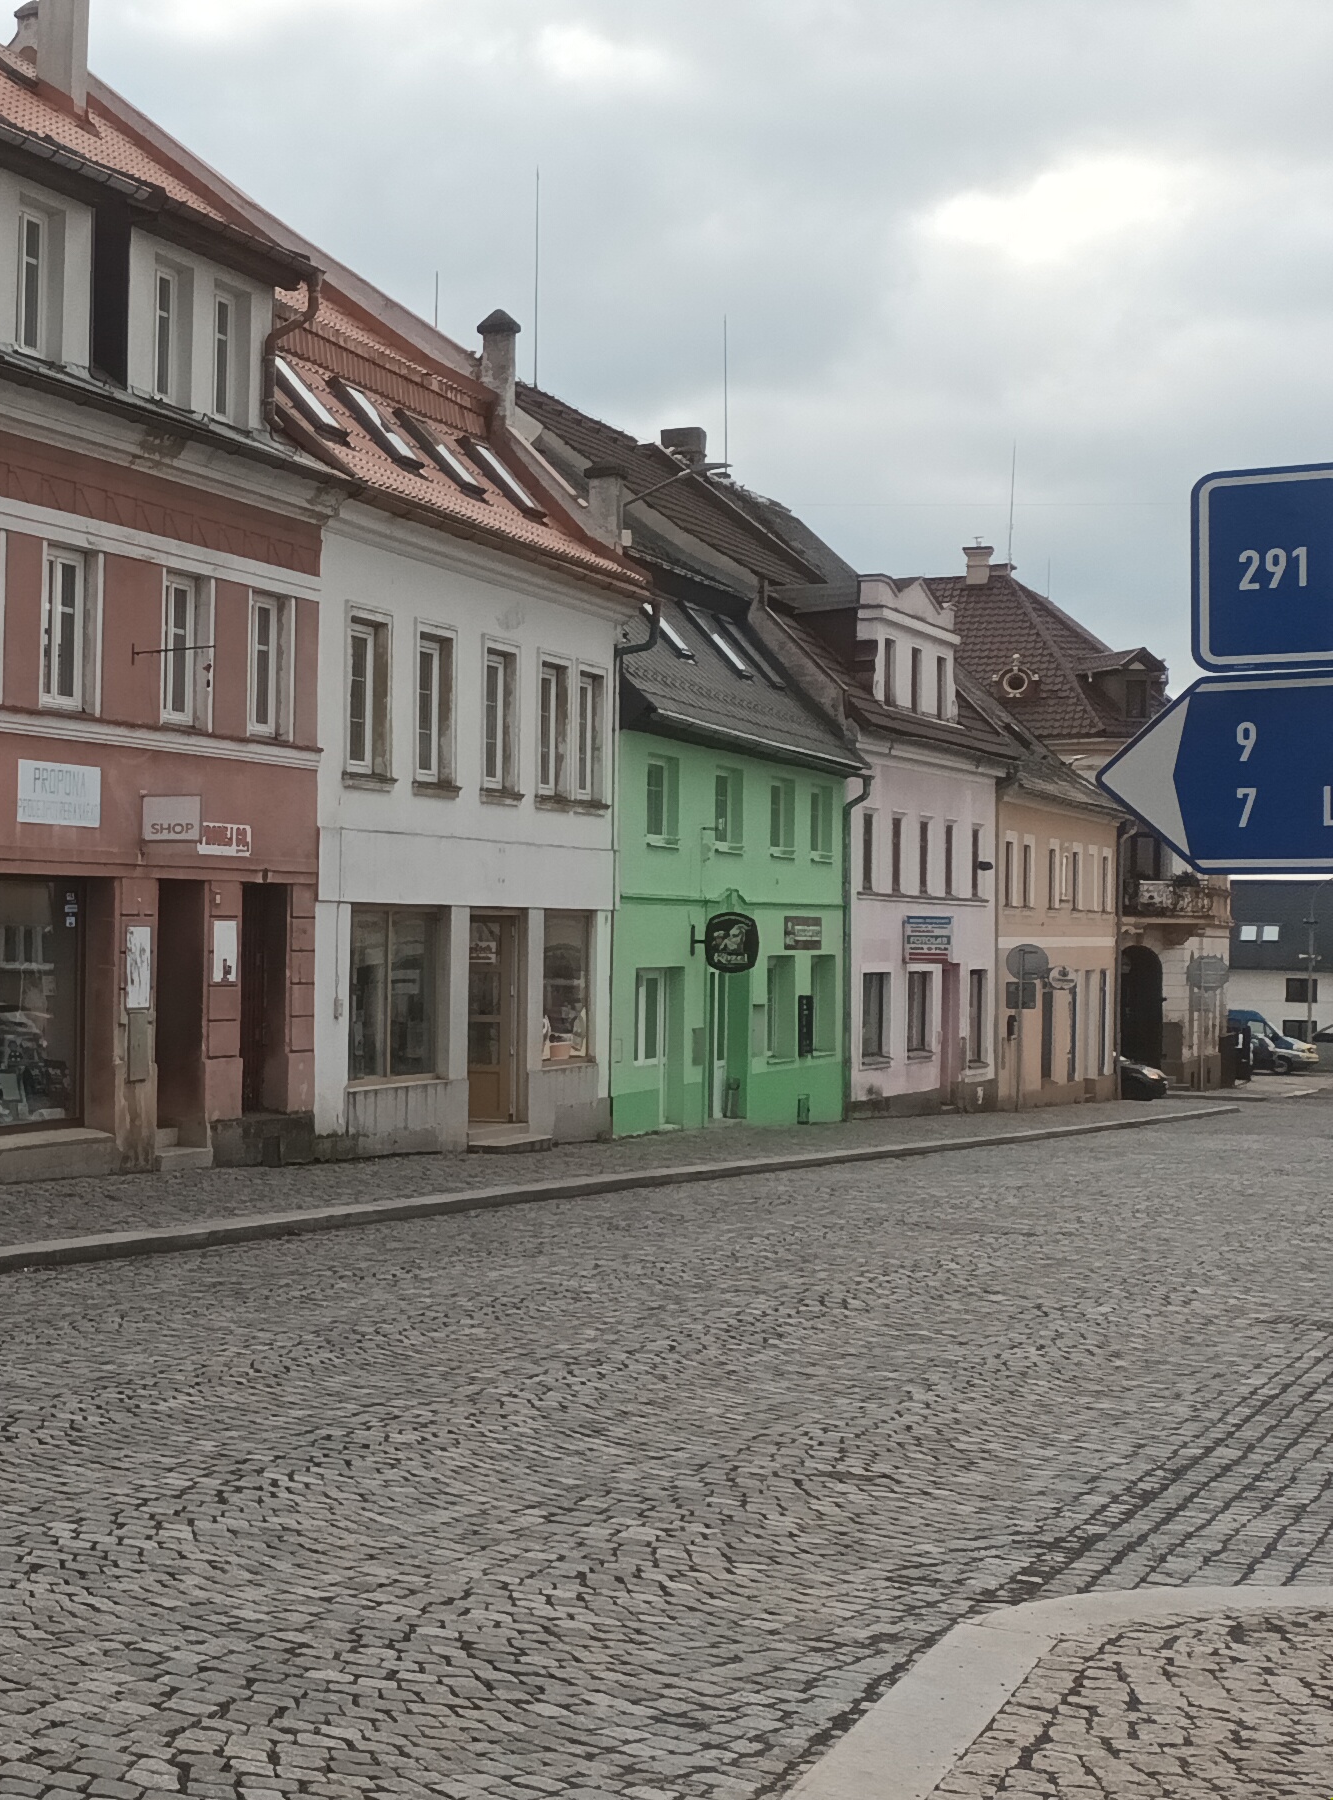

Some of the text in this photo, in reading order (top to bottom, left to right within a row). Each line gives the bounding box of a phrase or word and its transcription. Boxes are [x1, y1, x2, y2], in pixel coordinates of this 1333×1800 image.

[1238, 547, 1308, 591] 291
[1236, 722, 1257, 762] 9
[33, 767, 86, 797] PROPONA
[1236, 787, 1257, 828] 7
[151, 823, 194, 834] SHOP
